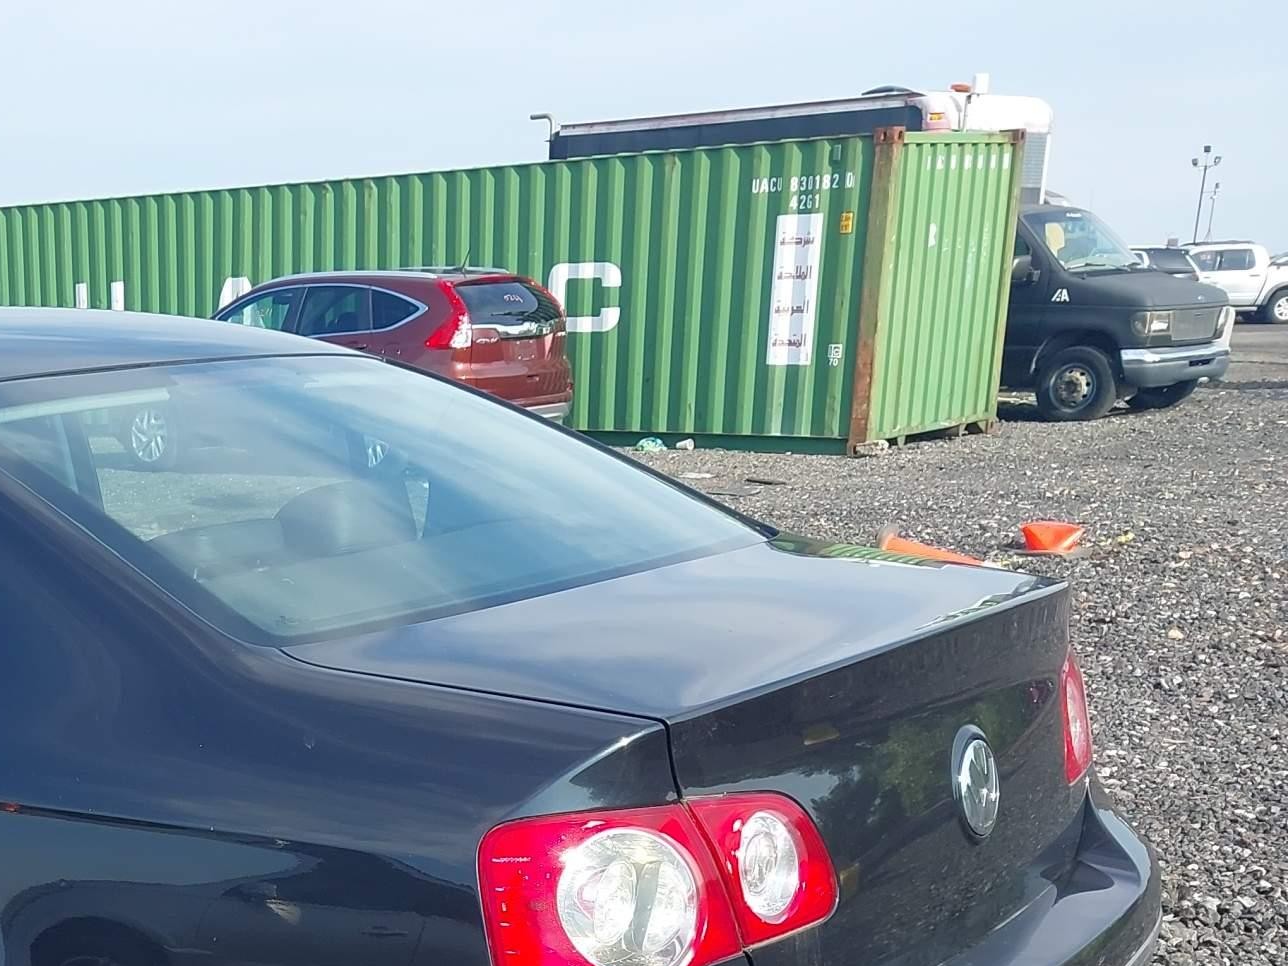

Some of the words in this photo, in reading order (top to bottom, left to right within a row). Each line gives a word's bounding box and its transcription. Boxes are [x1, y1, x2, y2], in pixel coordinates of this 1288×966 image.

[752, 176, 783, 193] UACU
[790, 173, 840, 192] 830182
[789, 193, 820, 210] 42G1
[829, 358, 839, 367] 70
